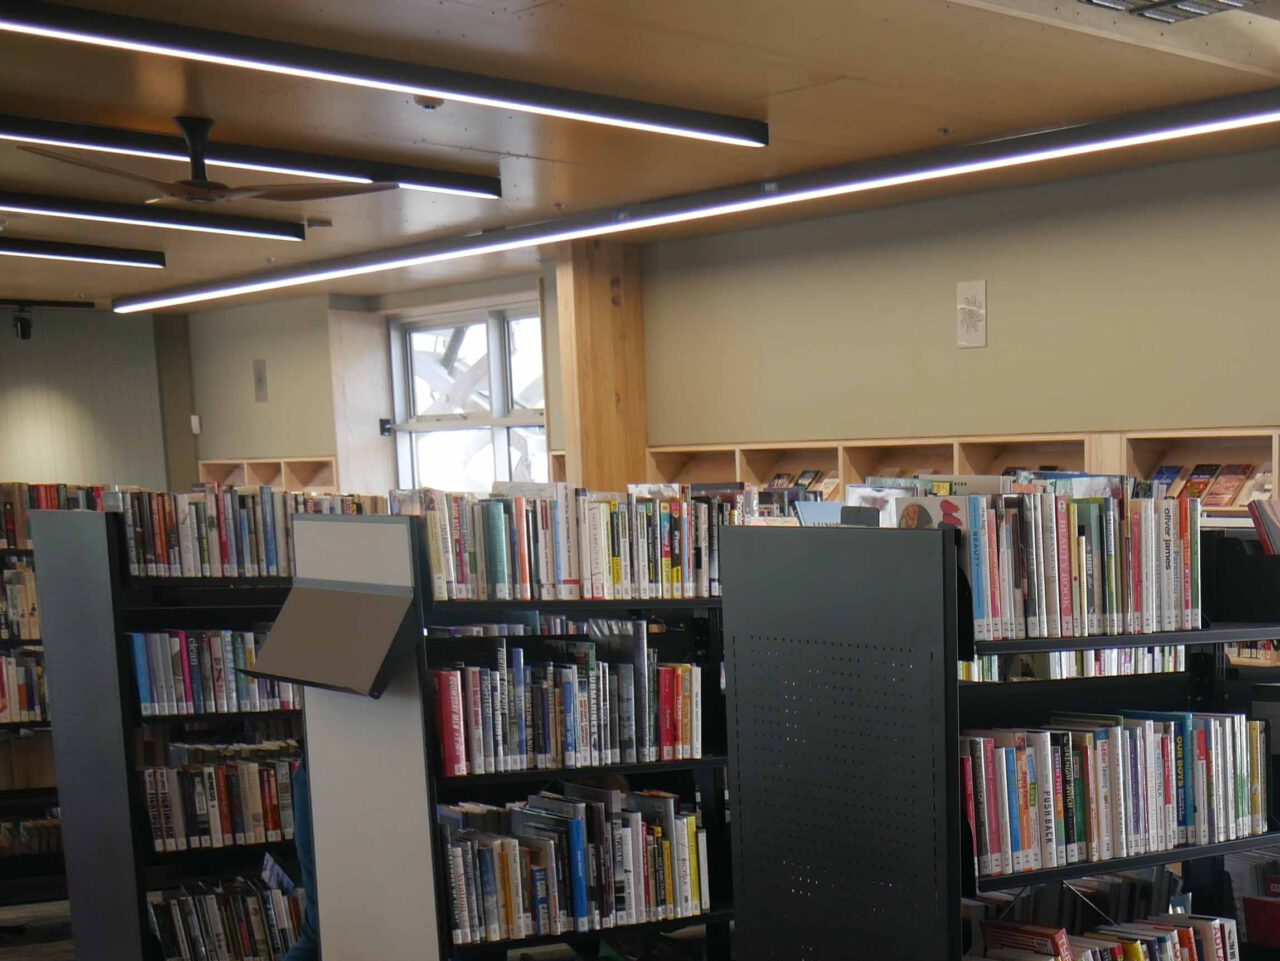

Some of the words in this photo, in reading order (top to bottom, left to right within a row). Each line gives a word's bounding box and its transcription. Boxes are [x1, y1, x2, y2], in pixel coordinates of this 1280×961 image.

[1163, 508, 1172, 537] oliver
[972, 531, 980, 569] BEAUTY
[1058, 519, 1069, 570] BEAUTY
[1163, 539, 1172, 570] james
[1061, 574, 1071, 609] BOOK
[187, 637, 199, 666] clean
[524, 692, 532, 726] BOATING
[588, 670, 598, 732] SUBMARINES
[1100, 741, 1108, 764] Toddler
[207, 772, 216, 802] NEMESIS
[1043, 791, 1052, 816] PUSH
[614, 830, 624, 862] JAGUAR
[1044, 818, 1054, 844] BACK
[457, 872, 468, 913] Aviation
